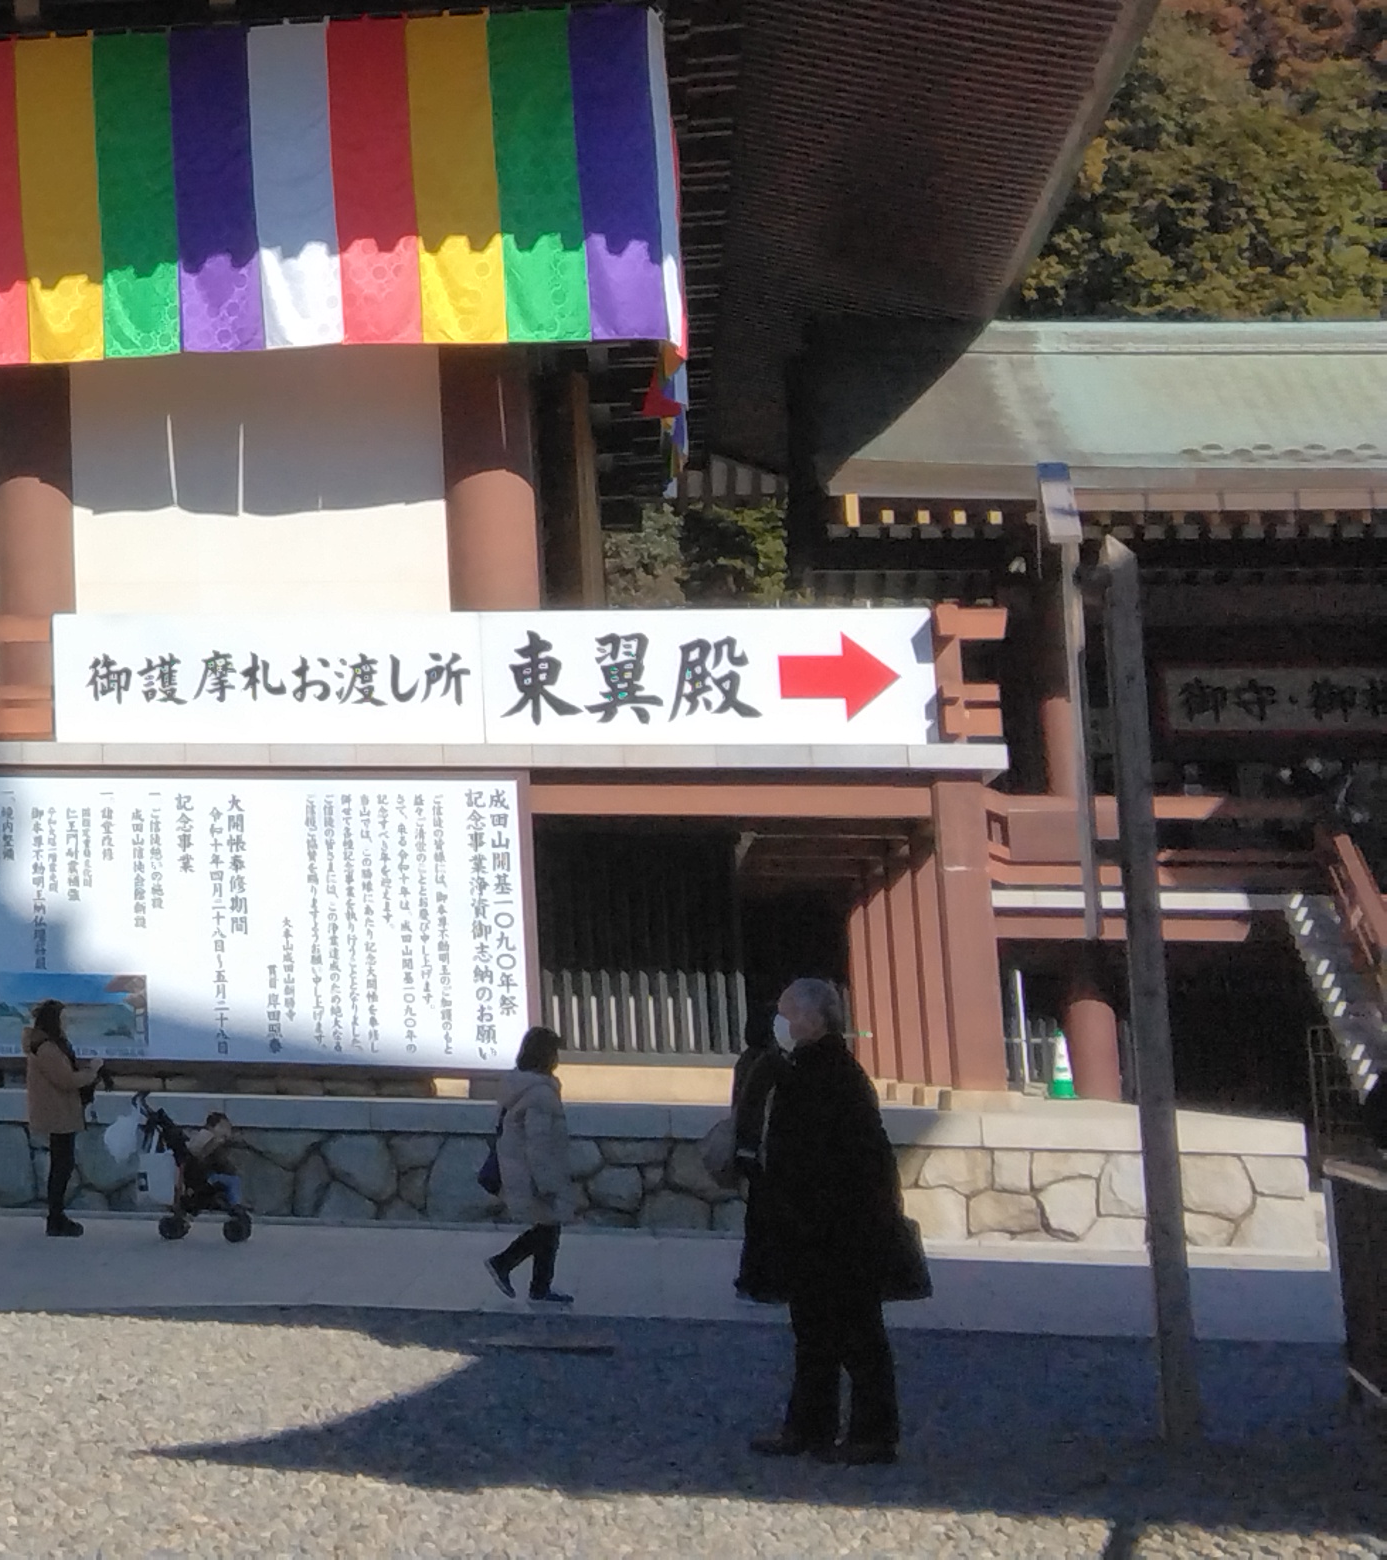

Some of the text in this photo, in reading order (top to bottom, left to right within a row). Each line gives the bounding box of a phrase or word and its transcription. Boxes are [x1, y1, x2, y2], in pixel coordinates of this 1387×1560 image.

[85, 630, 764, 726] 御護摩札お渡し所 東翼殿
[174, 793, 196, 874] 記念事業
